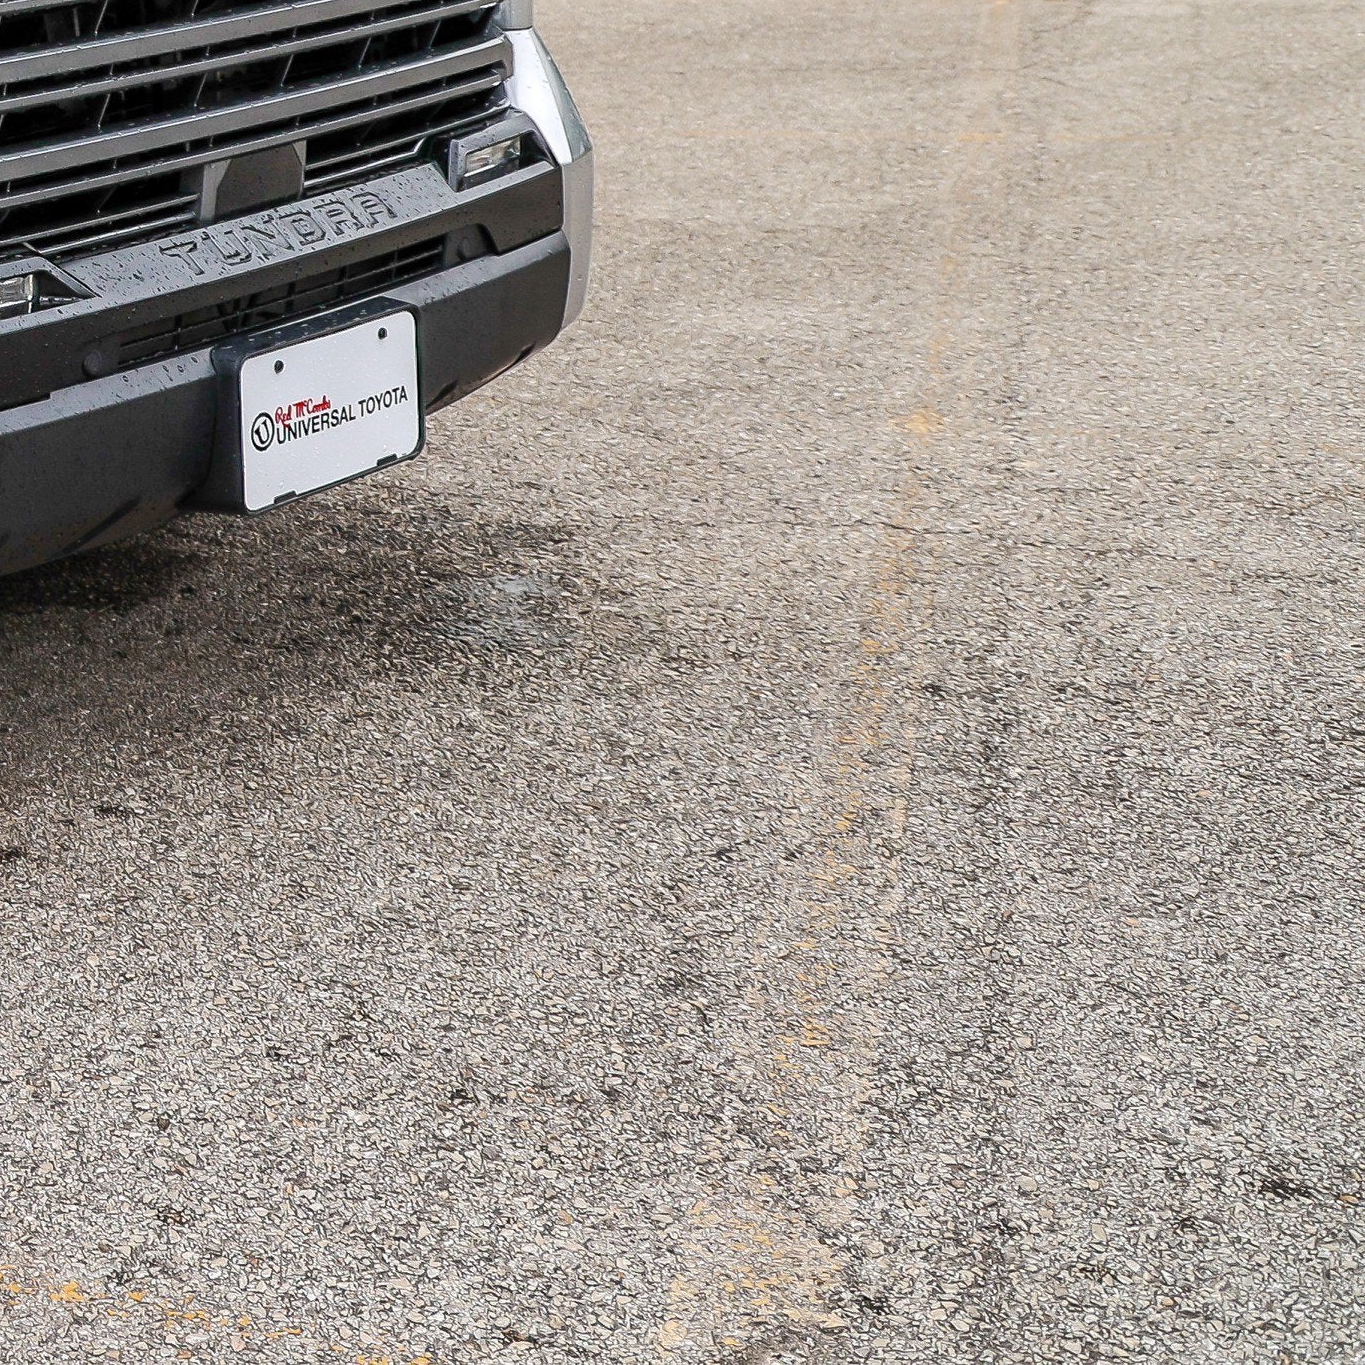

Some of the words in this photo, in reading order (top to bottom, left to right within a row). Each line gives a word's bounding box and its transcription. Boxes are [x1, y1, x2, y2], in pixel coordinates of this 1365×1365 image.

[159, 191, 398, 276] TUNDRA
[275, 406, 292, 426] Red
[276, 404, 356, 444] UNIVERSAL
[358, 385, 408, 417] TOYOTA
